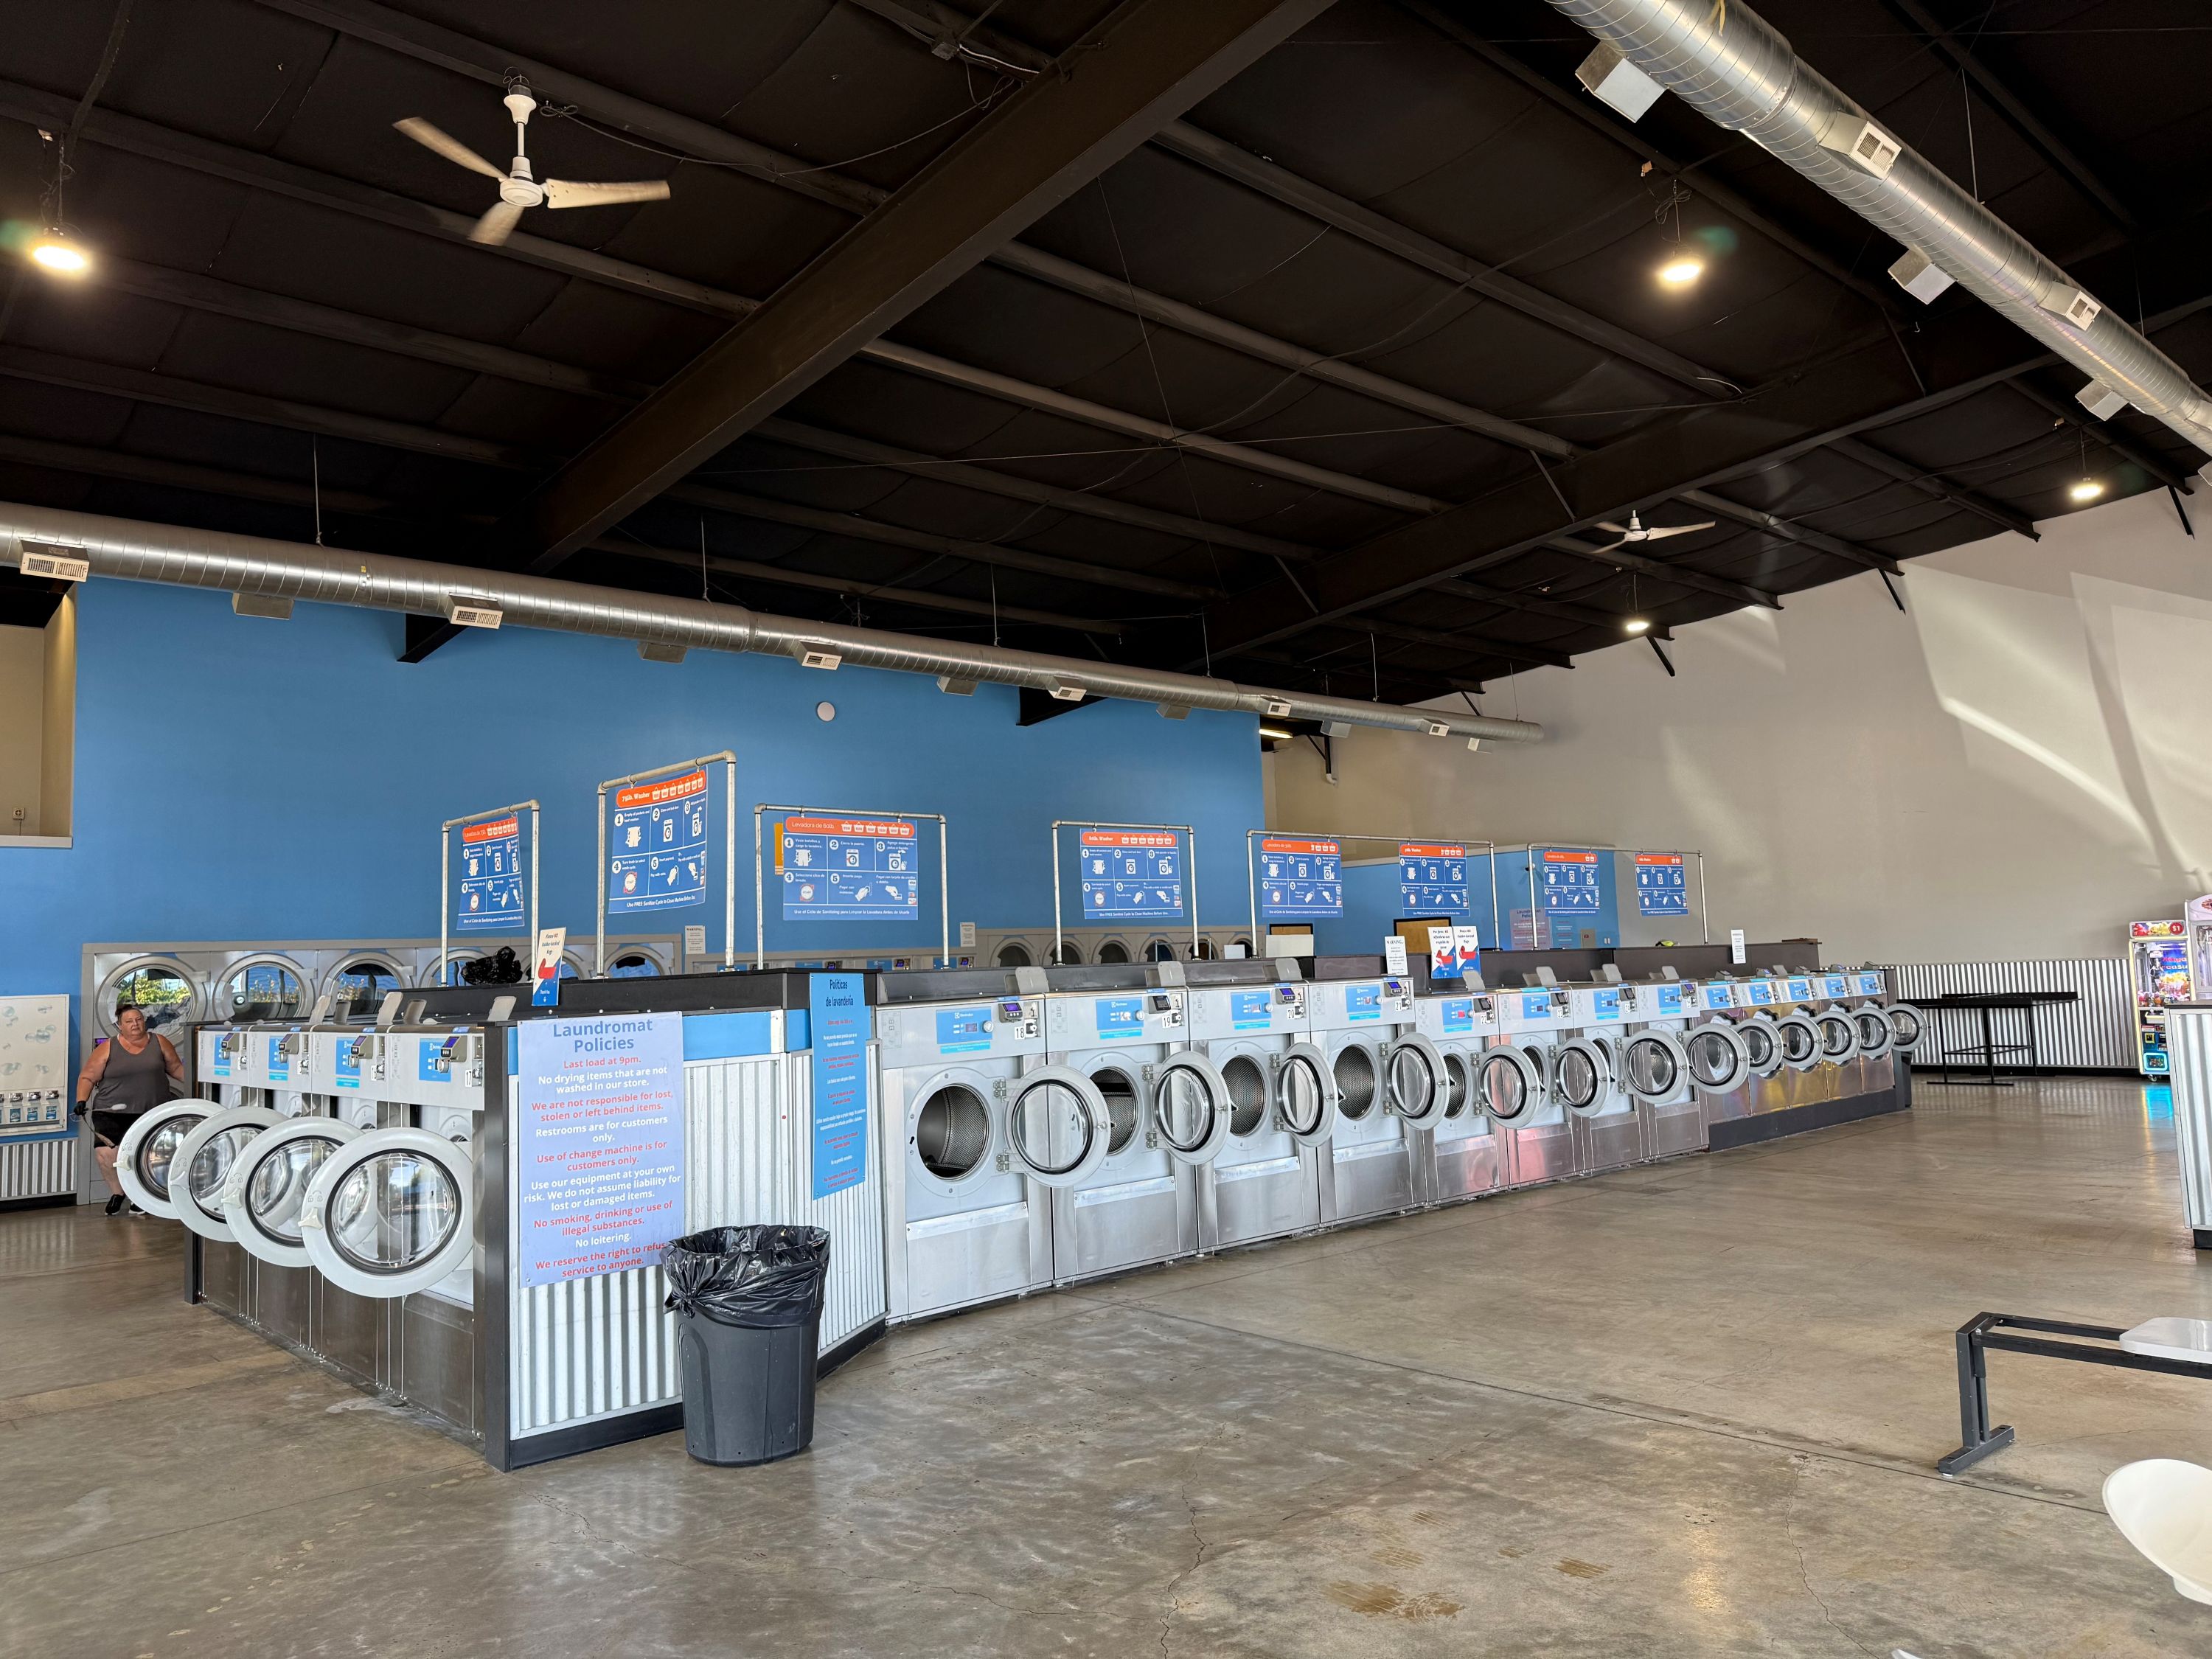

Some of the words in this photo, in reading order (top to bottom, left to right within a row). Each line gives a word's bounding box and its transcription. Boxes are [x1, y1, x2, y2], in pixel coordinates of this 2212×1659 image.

[826, 997, 831, 1006] de
[1164, 1017, 1170, 1027] 19
[1288, 1010, 1294, 1018] 20
[553, 1019, 653, 1037] Laundromat
[1016, 1027, 1024, 1038] 18
[574, 1037, 634, 1053] Policies
[564, 1060, 583, 1069] Last
[585, 1057, 605, 1067] load
[620, 1056, 641, 1065] 9pm.
[539, 1076, 552, 1085] No
[554, 1073, 585, 1085] drying
[587, 1072, 613, 1081] items
[615, 1069, 634, 1078] that
[636, 1068, 650, 1077] are
[556, 1084, 592, 1094] washed
[624, 1078, 650, 1088] store.
[532, 1102, 546, 1110] We
[586, 1093, 638, 1106] responsible
[641, 1092, 653, 1100] for
[655, 1090, 673, 1099] lost,
[541, 1112, 570, 1121] stolen
[585, 1108, 601, 1117] left
[603, 1105, 634, 1116] behind
[637, 1103, 663, 1112] items.
[536, 1124, 586, 1138] Restrooms
[589, 1123, 604, 1131] are
[607, 1121, 619, 1130] for
[622, 1116, 667, 1127] customers
[593, 1133, 615, 1143] only.
[537, 1155, 554, 1163] Use
[557, 1152, 567, 1161] of
[569, 1150, 602, 1159] change
[605, 1144, 643, 1155] machine
[645, 1142, 652, 1150] is
[655, 1141, 667, 1149] for
[567, 1159, 615, 1172] customers
[619, 1155, 639, 1165] only.
[532, 1181, 549, 1190] Use
[552, 1179, 567, 1187] our
[571, 1171, 620, 1186] equipment
[623, 1170, 632, 1178] at
[634, 1167, 655, 1179] your
[657, 1165, 675, 1174] own
[524, 1193, 544, 1203] risk.
[548, 1190, 563, 1200] We
[565, 1189, 577, 1198] do
[580, 1187, 594, 1195] not
[597, 1183, 631, 1194] assume
[633, 1176, 667, 1189] liability
[669, 1175, 681, 1183] for
[552, 1201, 568, 1211] lost
[571, 1200, 581, 1208] or
[584, 1193, 625, 1206] damaged
[627, 1190, 655, 1200] items.
[535, 1220, 548, 1228] No
[551, 1214, 592, 1226] smoking,
[595, 1205, 632, 1220] drinking
[635, 1206, 644, 1214] or
[647, 1204, 661, 1212] use
[664, 1200, 673, 1209] of
[563, 1225, 590, 1237] illegal
[592, 1217, 644, 1231] substances.
[576, 1239, 588, 1248] No
[591, 1232, 631, 1246] loitering.
[536, 1260, 550, 1270] We
[554, 1255, 588, 1267] reserve
[591, 1251, 605, 1261] the
[608, 1248, 630, 1259] right
[632, 1245, 641, 1253] to
[643, 1243, 667, 1252] refus
[562, 1265, 594, 1277] service
[597, 1262, 606, 1271] to
[609, 1257, 644, 1270] anyone.
